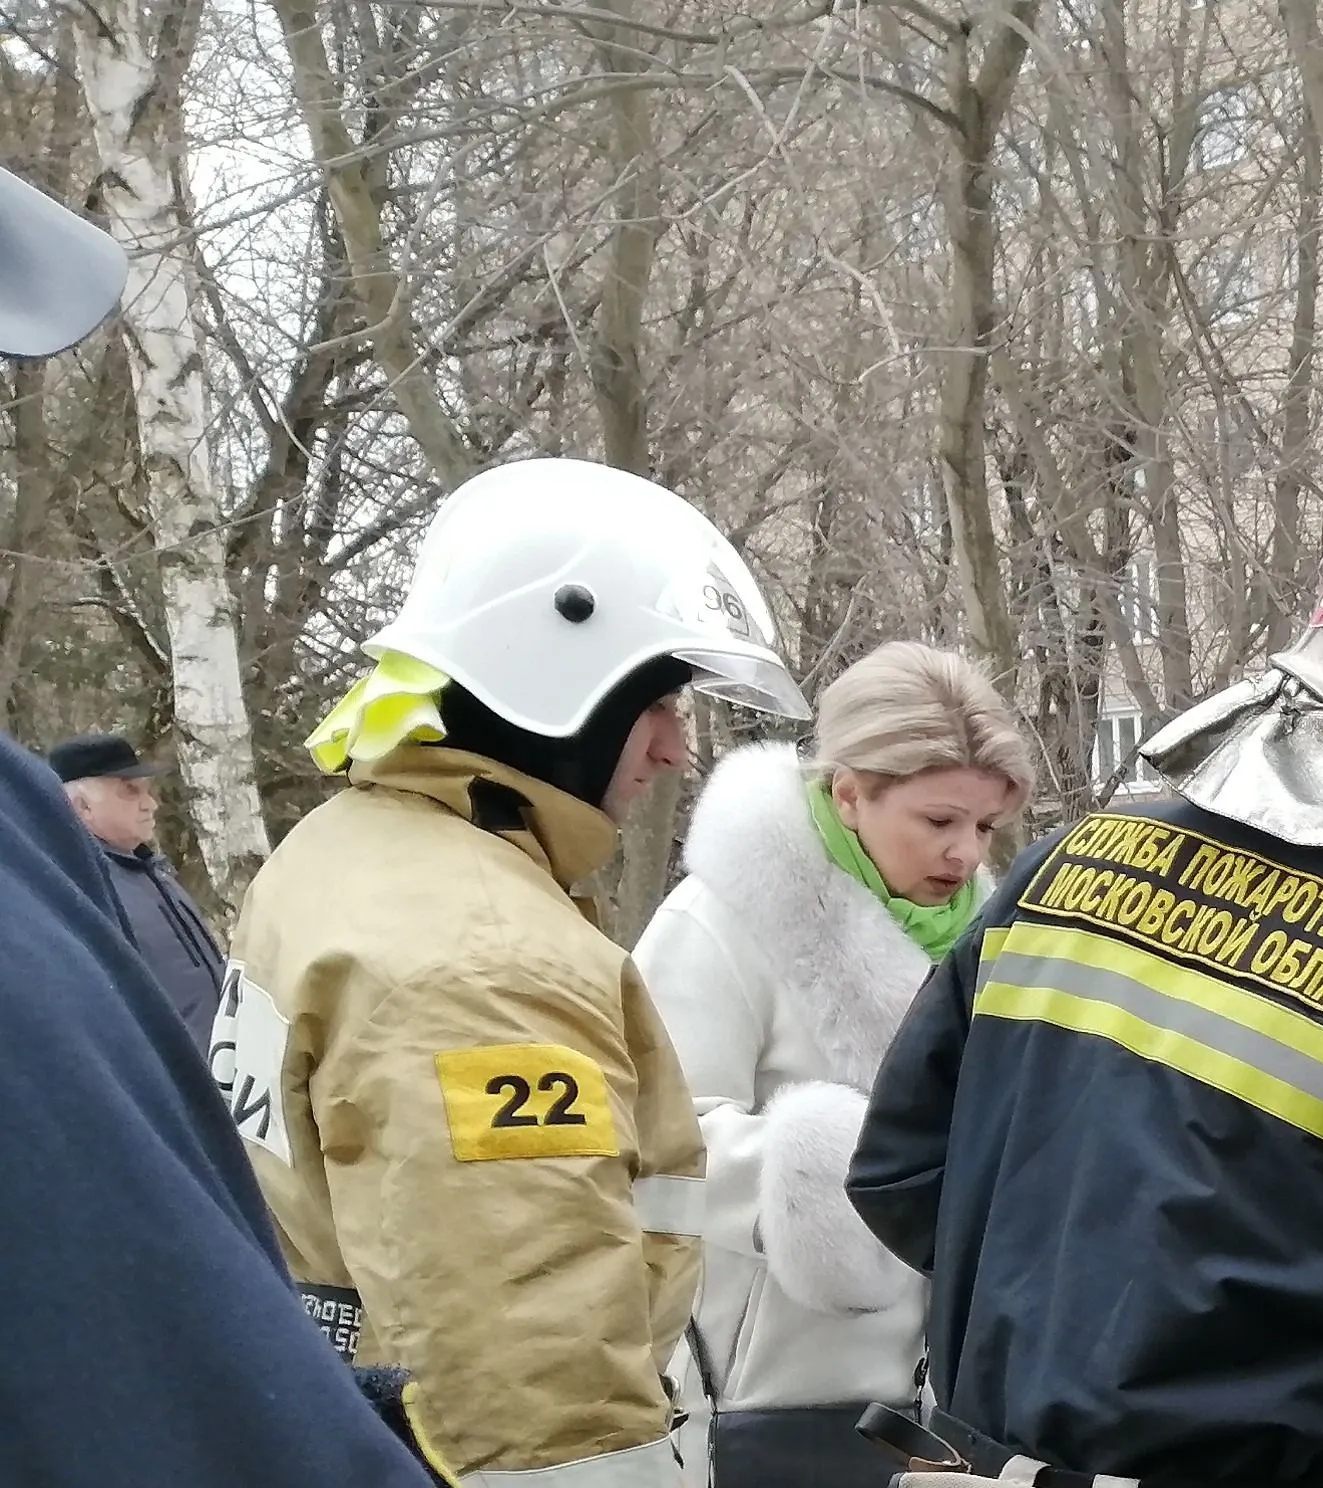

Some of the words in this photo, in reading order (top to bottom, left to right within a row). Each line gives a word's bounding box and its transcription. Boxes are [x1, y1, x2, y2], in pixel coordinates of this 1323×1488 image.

[1065, 818, 1186, 877] СЛУЖБА
[1040, 862, 1262, 967] МОСКОВСКОЙ
[485, 1072, 586, 1129] 22
